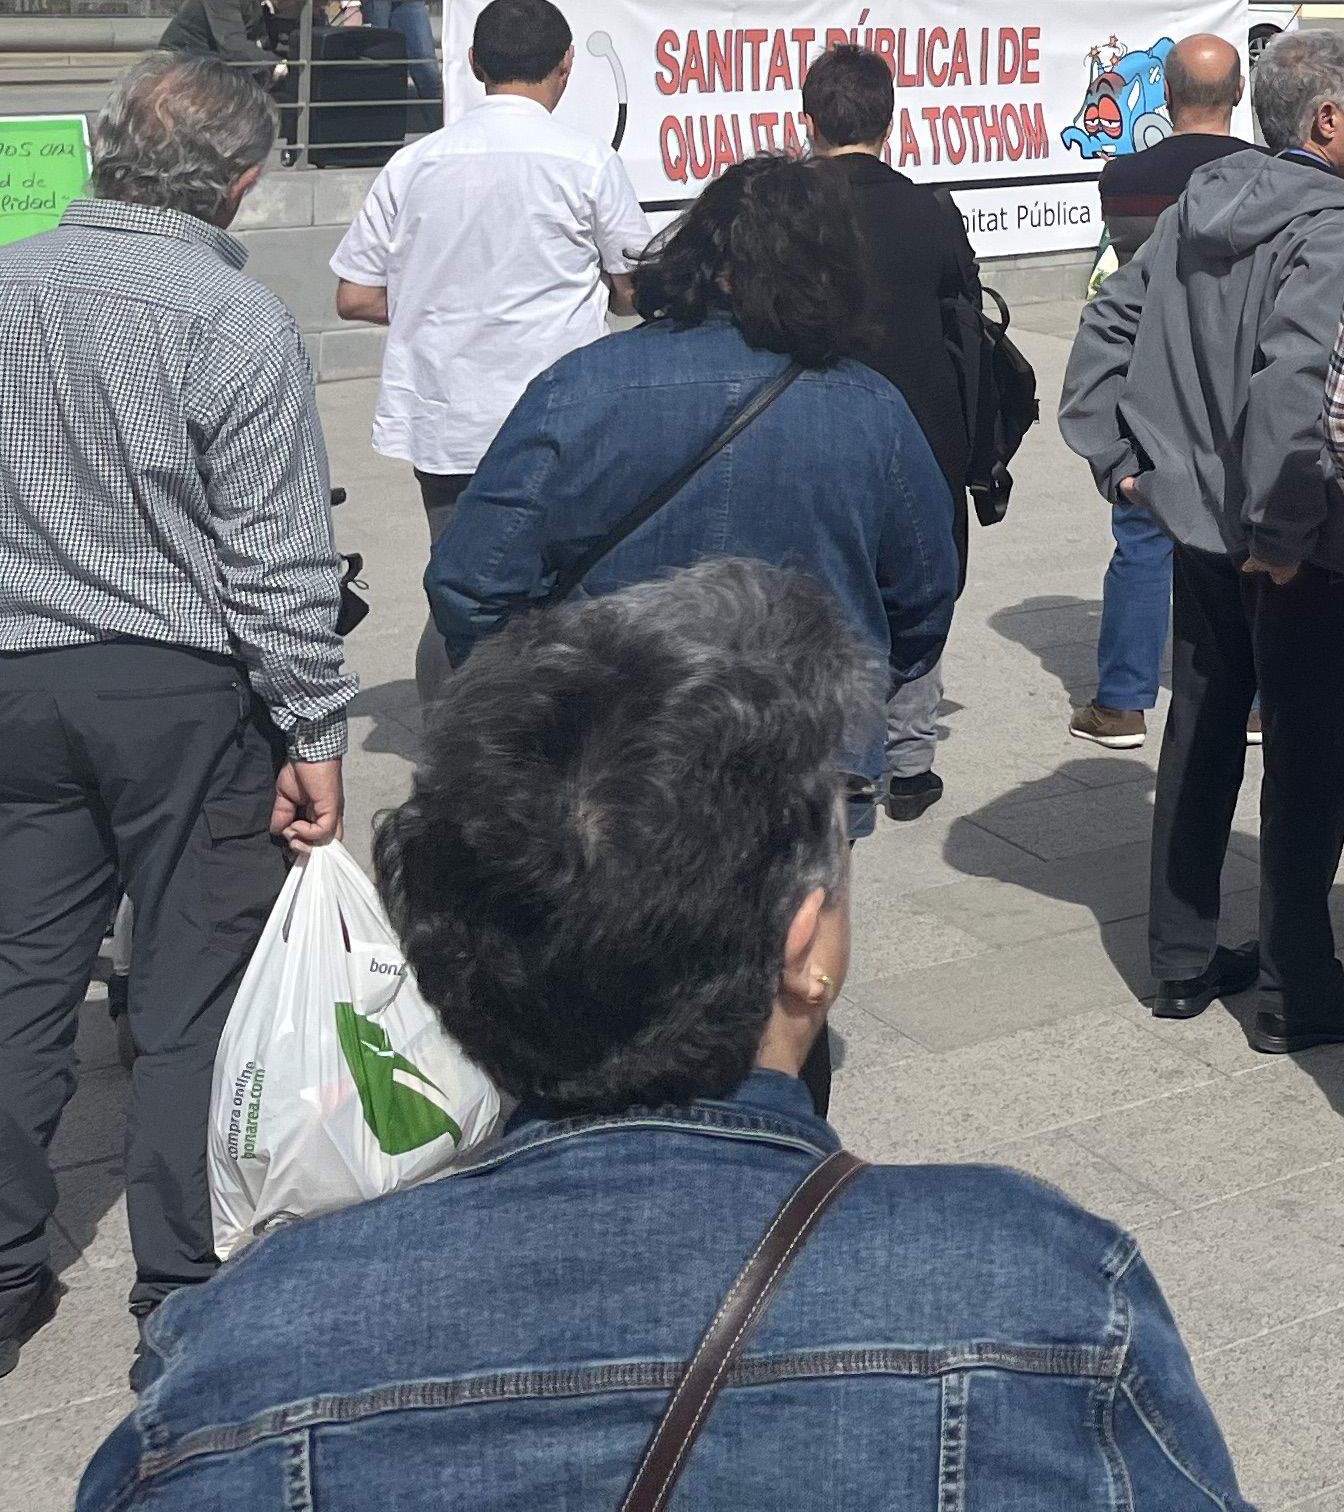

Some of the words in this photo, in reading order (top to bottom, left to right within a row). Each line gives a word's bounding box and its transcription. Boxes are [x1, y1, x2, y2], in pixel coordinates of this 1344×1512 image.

[655, 28, 816, 96] SANITAT
[979, 27, 989, 85] I
[997, 26, 1041, 85] DE
[898, 107, 922, 168] A
[921, 102, 1050, 166] TOTHOM
[22, 172, 47, 188] de
[961, 207, 1009, 234] nitat
[1017, 200, 1091, 229] Pública
[233, 1061, 256, 1107] online
[227, 1109, 242, 1161] compra
[241, 1068, 266, 1160] bonarea.com
